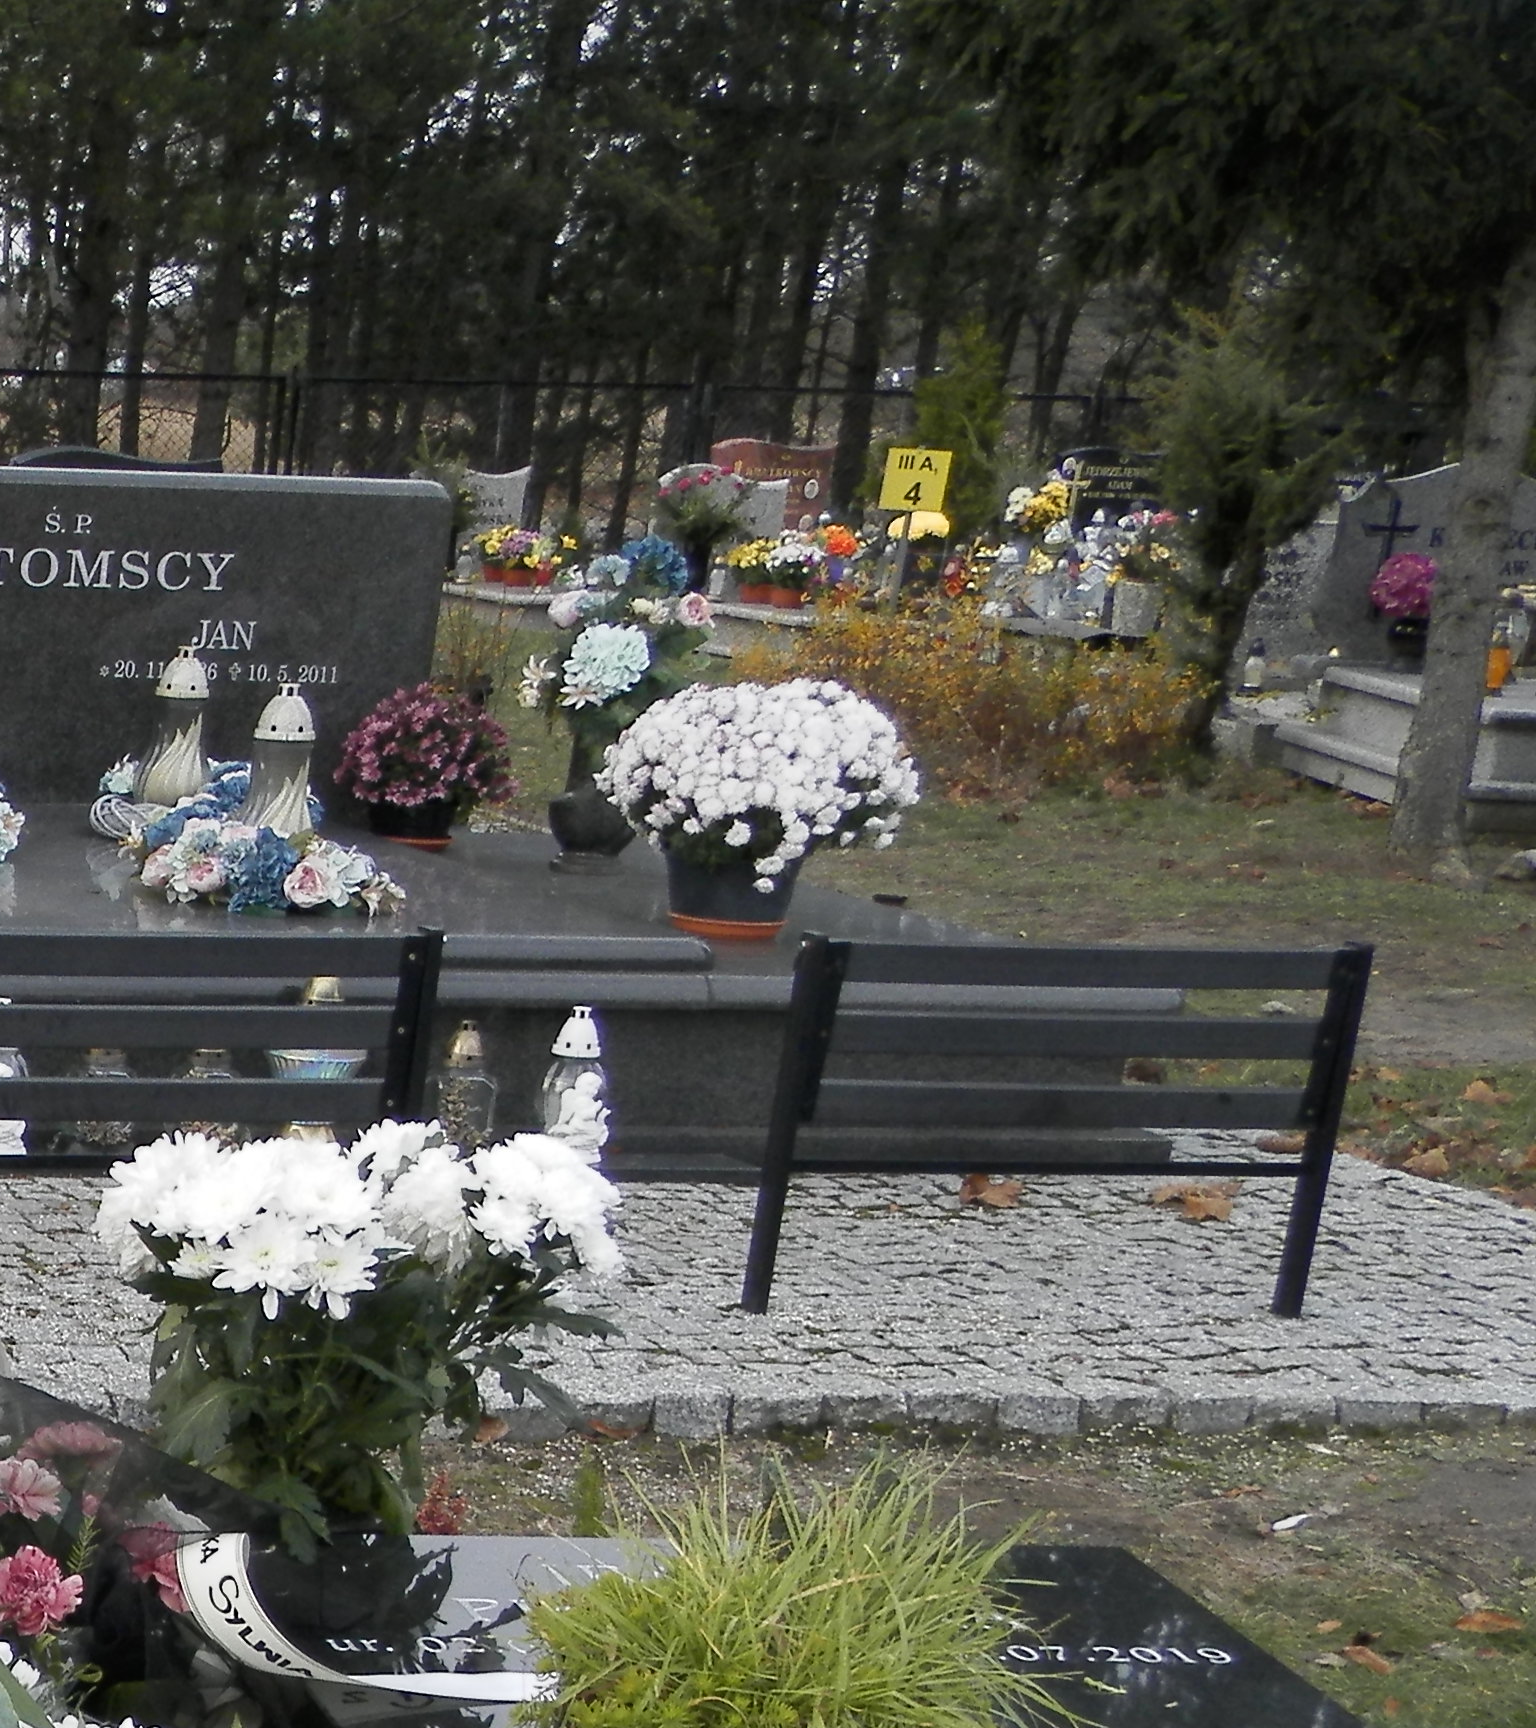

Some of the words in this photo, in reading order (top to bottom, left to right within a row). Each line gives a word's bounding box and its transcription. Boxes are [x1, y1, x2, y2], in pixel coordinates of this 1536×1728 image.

[903, 481, 922, 506] 4
[191, 618, 257, 651] JAN
[298, 664, 339, 685] 2011
[325, 1636, 394, 1653] ur.
